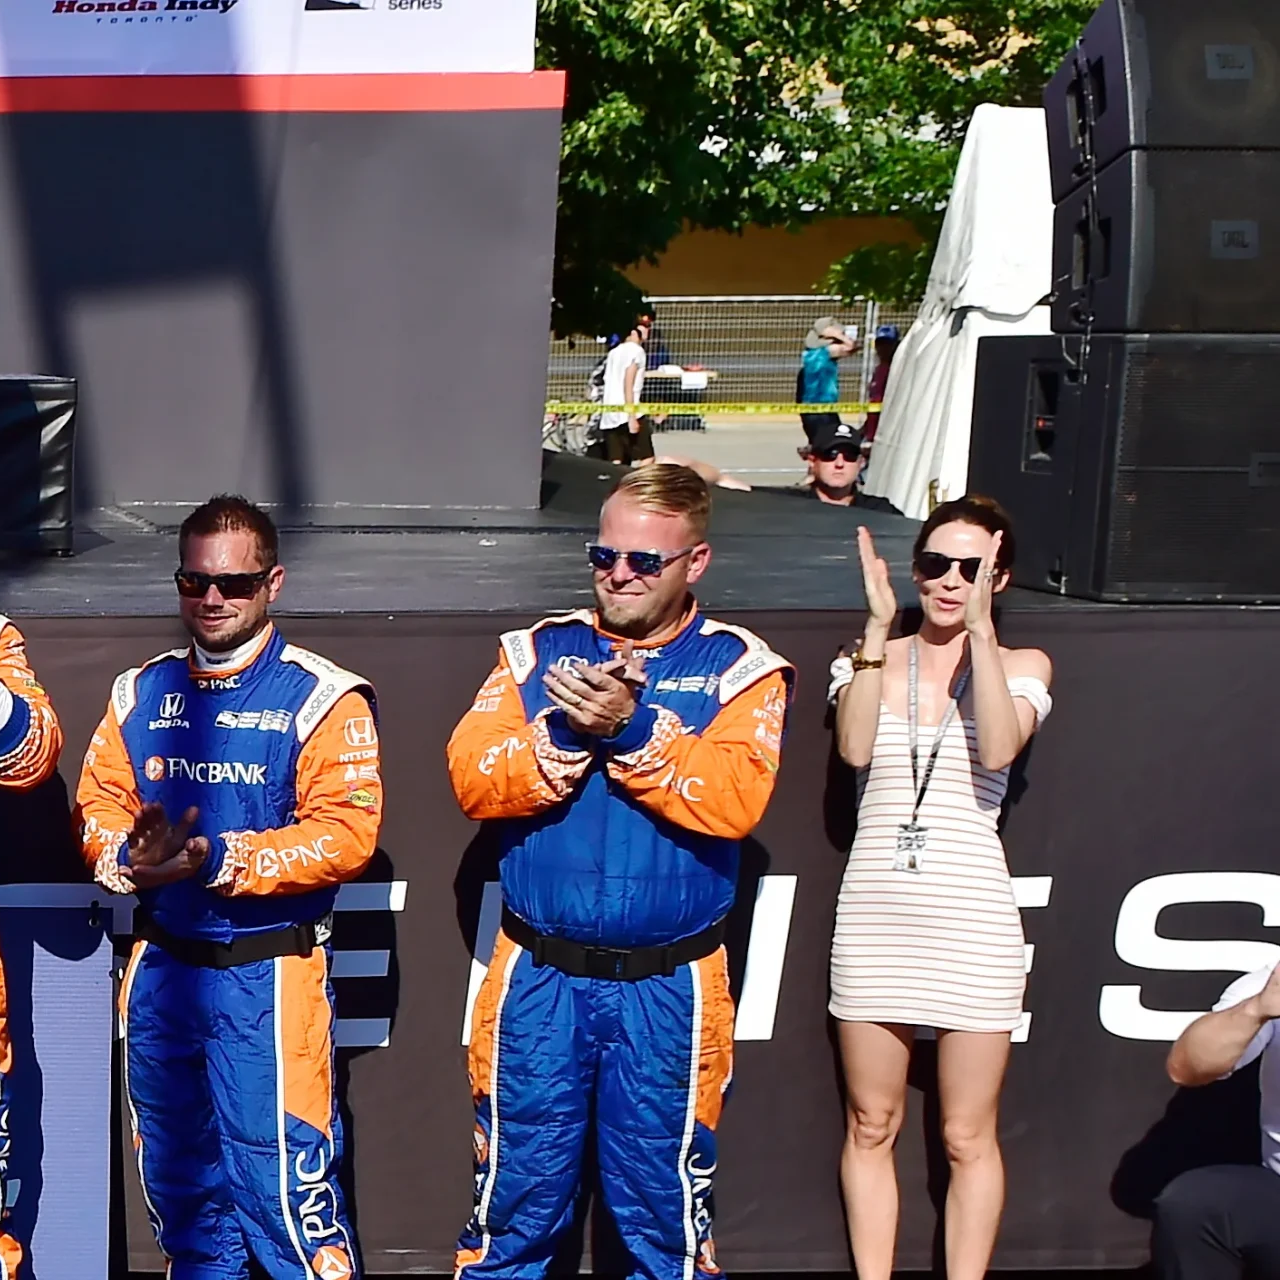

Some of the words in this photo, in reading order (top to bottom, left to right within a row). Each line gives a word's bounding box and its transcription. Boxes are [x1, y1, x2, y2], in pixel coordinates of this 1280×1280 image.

[210, 676, 242, 689] PNC
[167, 758, 268, 785] PNCBANK
[277, 835, 341, 872] PNC
[296, 1147, 338, 1244] PNC
